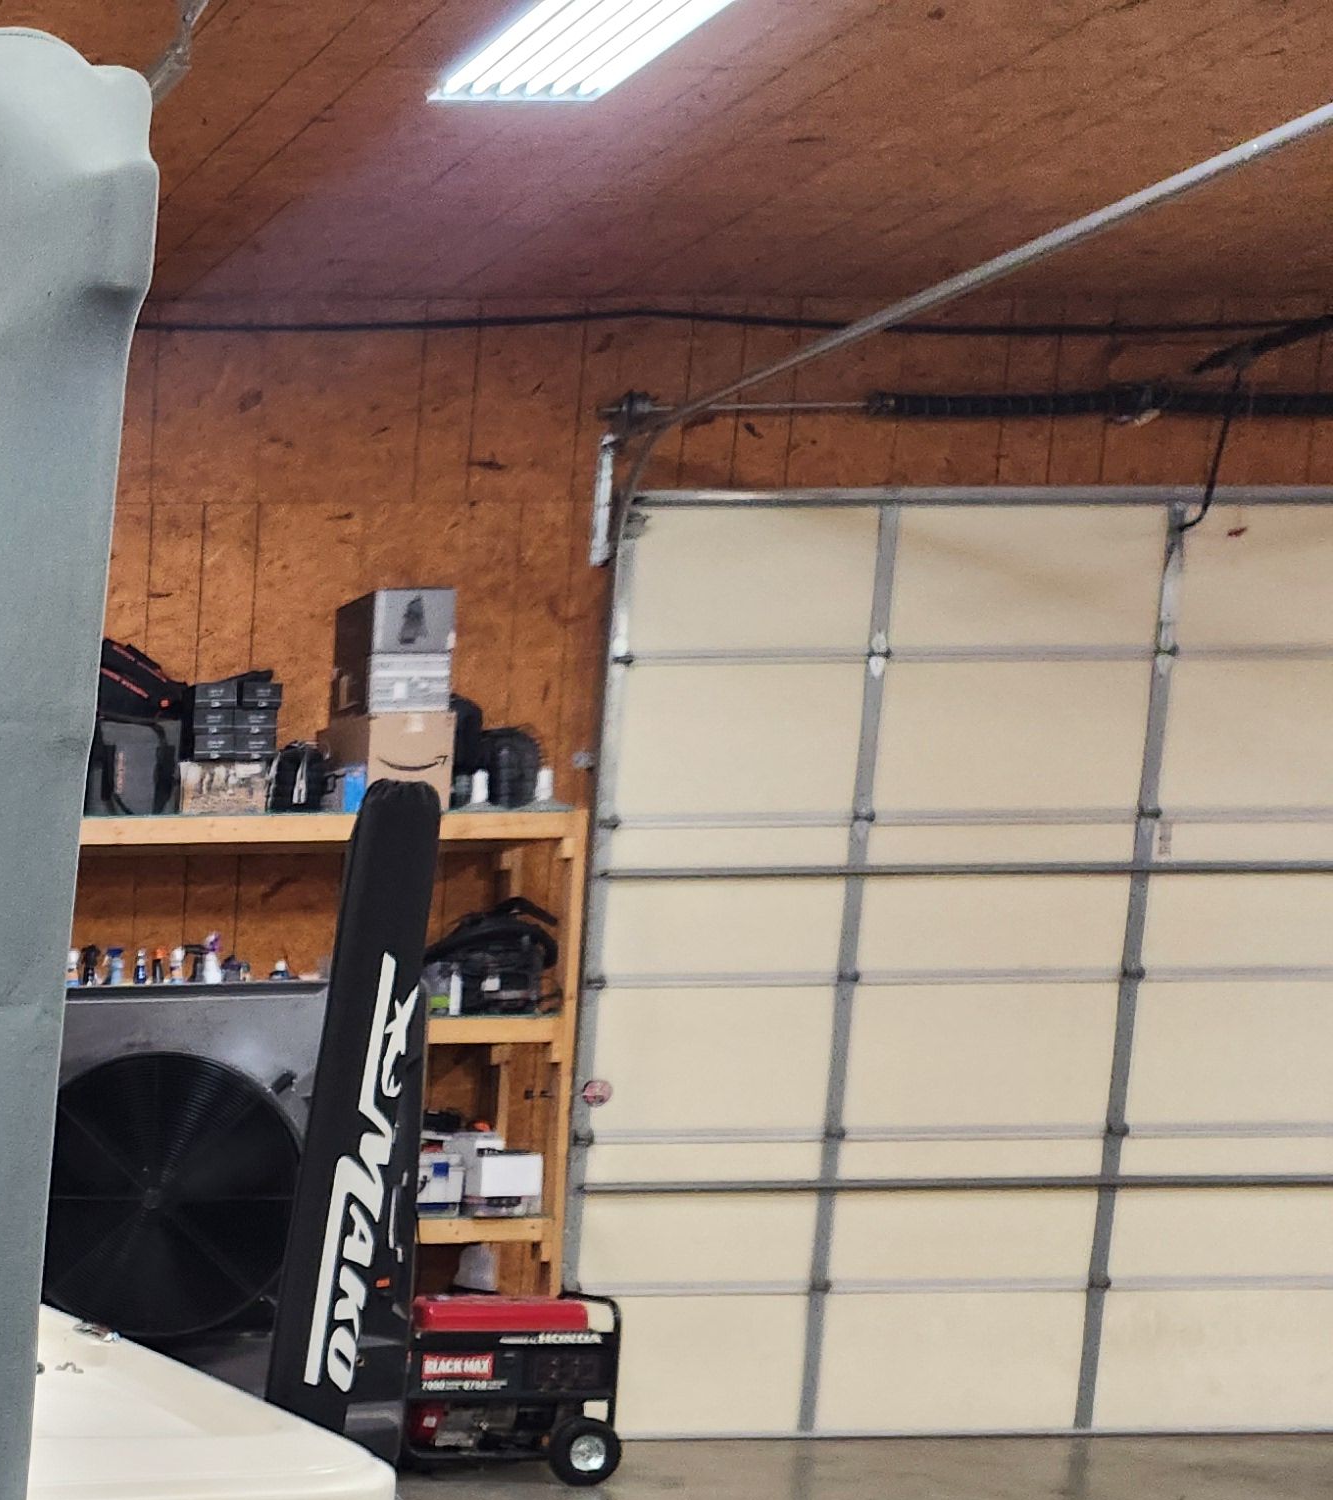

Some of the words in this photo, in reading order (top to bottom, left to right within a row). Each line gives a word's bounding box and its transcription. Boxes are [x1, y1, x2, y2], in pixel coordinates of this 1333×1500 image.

[304, 1060, 395, 1393] MAKO
[424, 1359, 463, 1374] BLACK
[463, 1358, 490, 1374] MAX
